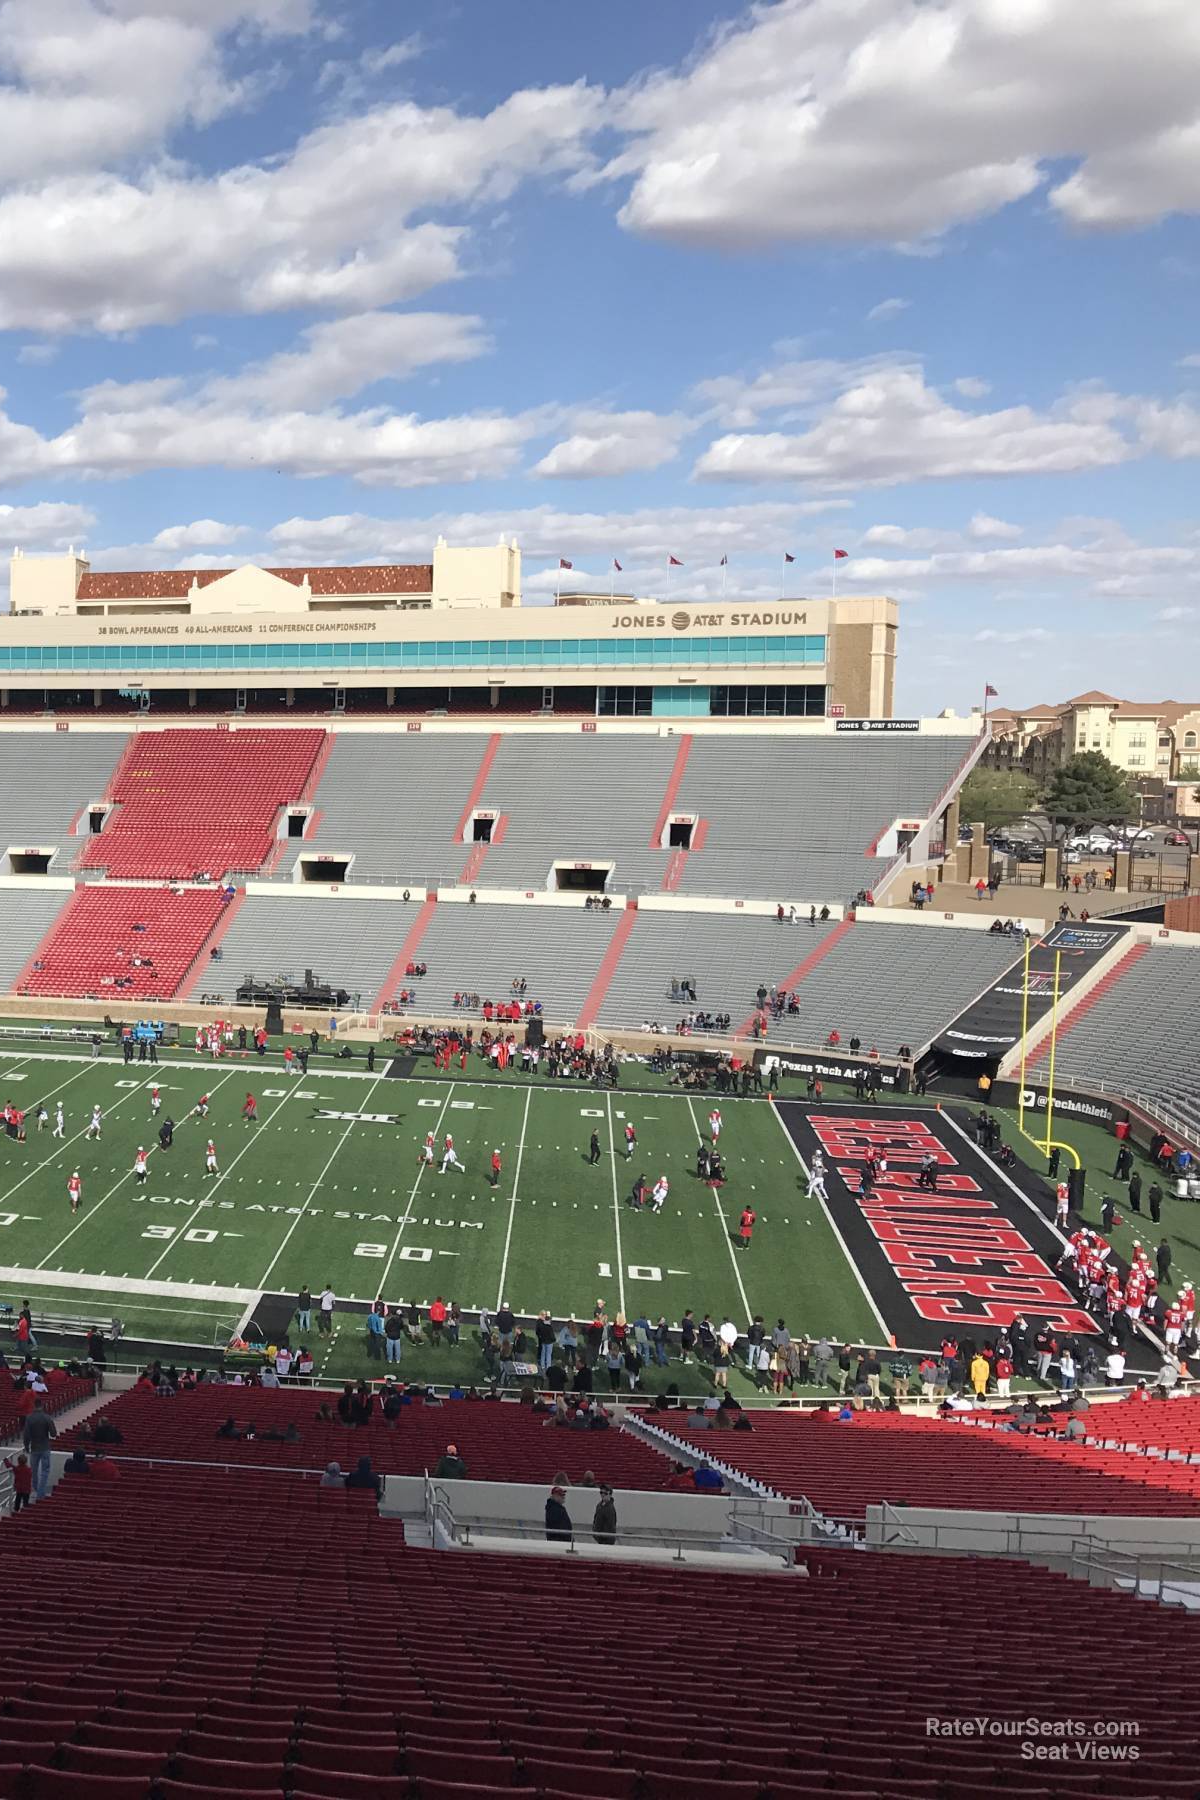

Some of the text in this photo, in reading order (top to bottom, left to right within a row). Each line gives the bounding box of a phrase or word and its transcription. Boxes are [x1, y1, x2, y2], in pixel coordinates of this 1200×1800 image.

[108, 626, 130, 635] BOWL
[130, 626, 179, 635] APPEARANCES
[195, 624, 253, 633] ALL-AMERICANS
[268, 623, 314, 633] CONFERENCE
[315, 622, 377, 632] CHAMPIONSHIPS
[612, 612, 808, 629] JONES AT&T STADIUM
[870, 722, 885, 730] AT&T
[887, 721, 919, 730] STADIUM
[945, 1030, 1017, 1043] GEICO
[951, 1048, 988, 1058] GEICO
[780, 1059, 813, 1074] Texas
[815, 1064, 842, 1078] Tech
[132, 1194, 486, 1230] JONES AT&T STADIUM
[141, 1224, 219, 1243] 30
[805, 1114, 1104, 1336] RED RAIDERS
[353, 1242, 433, 1262] 20
[598, 1262, 662, 1282] 10
